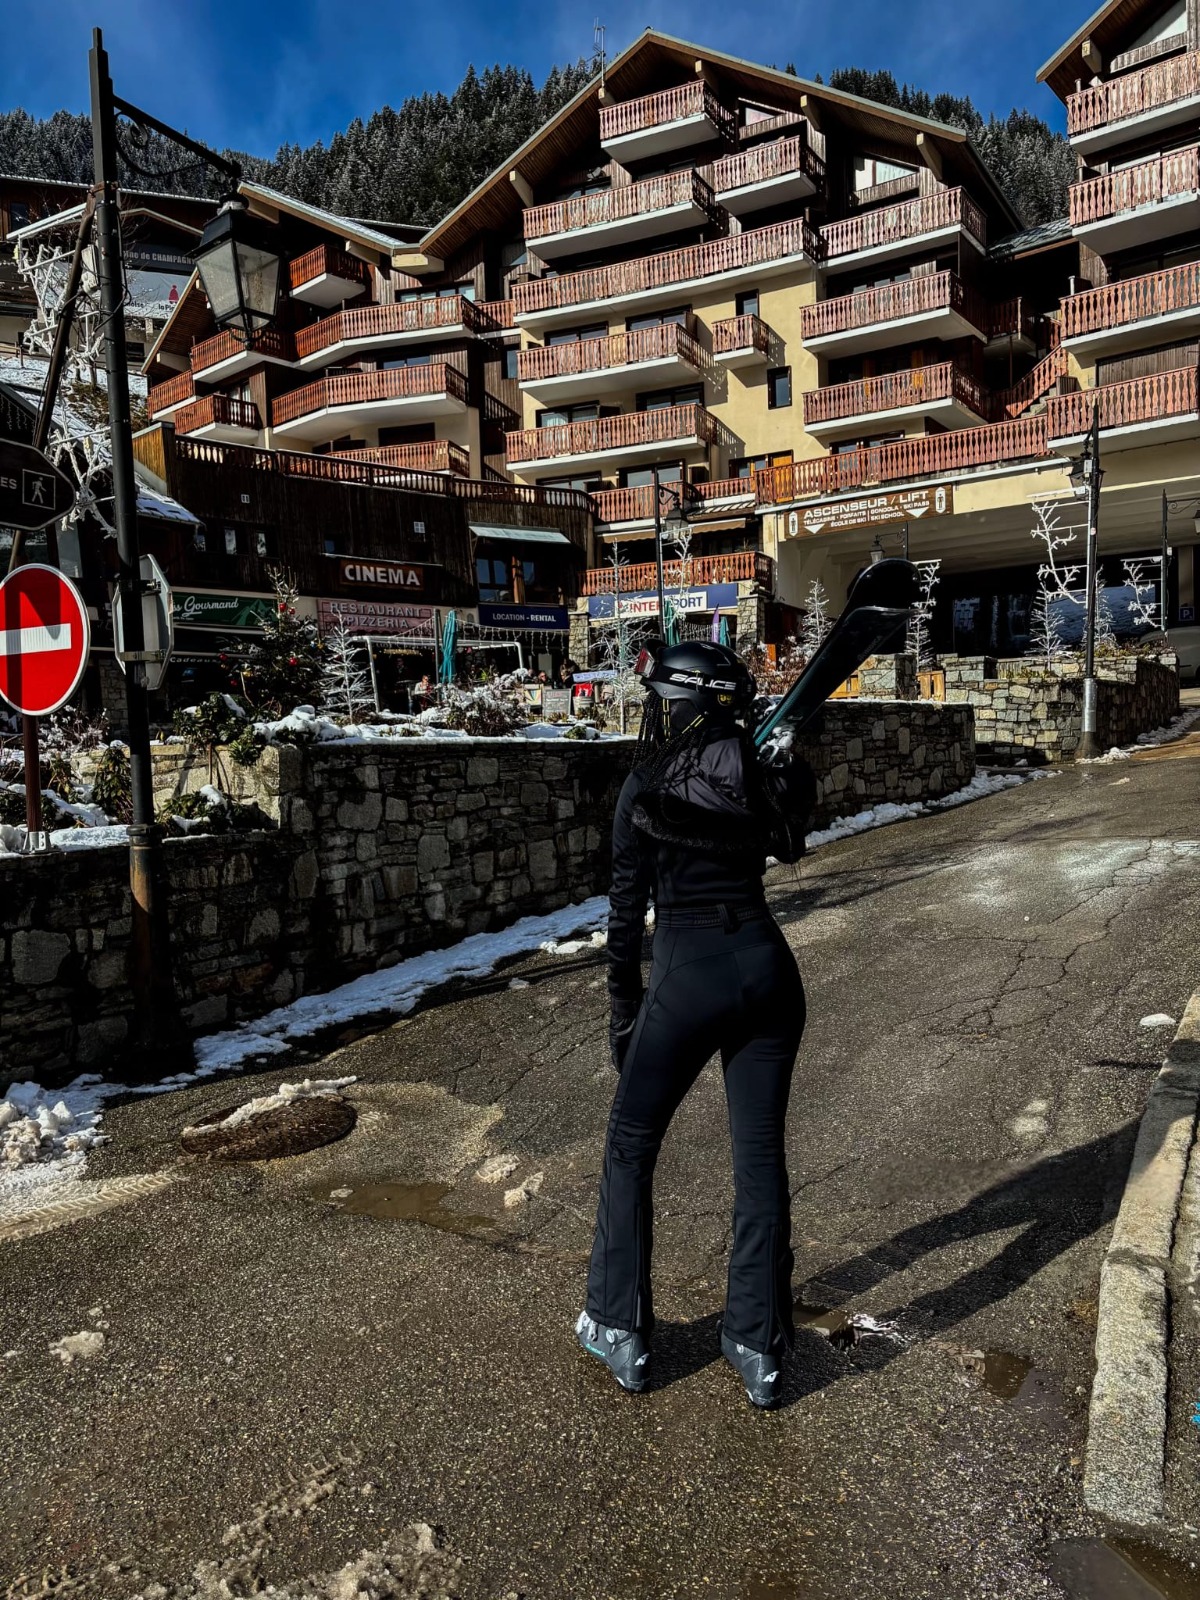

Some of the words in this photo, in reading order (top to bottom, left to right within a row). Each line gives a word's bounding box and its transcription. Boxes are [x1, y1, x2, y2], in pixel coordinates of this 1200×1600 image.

[140, 252, 151, 260] de
[803, 497, 888, 519] ASCENSEUR
[899, 490, 929, 504] LIFT
[880, 511, 905, 520] SCHOOL
[344, 564, 421, 586] CINEMA
[182, 595, 239, 617] Gourmand
[330, 602, 422, 617] RESTAURANT
[347, 616, 409, 628] PIZZERIA
[492, 612, 525, 621] LOCATION
[530, 614, 557, 622] RENTAL
